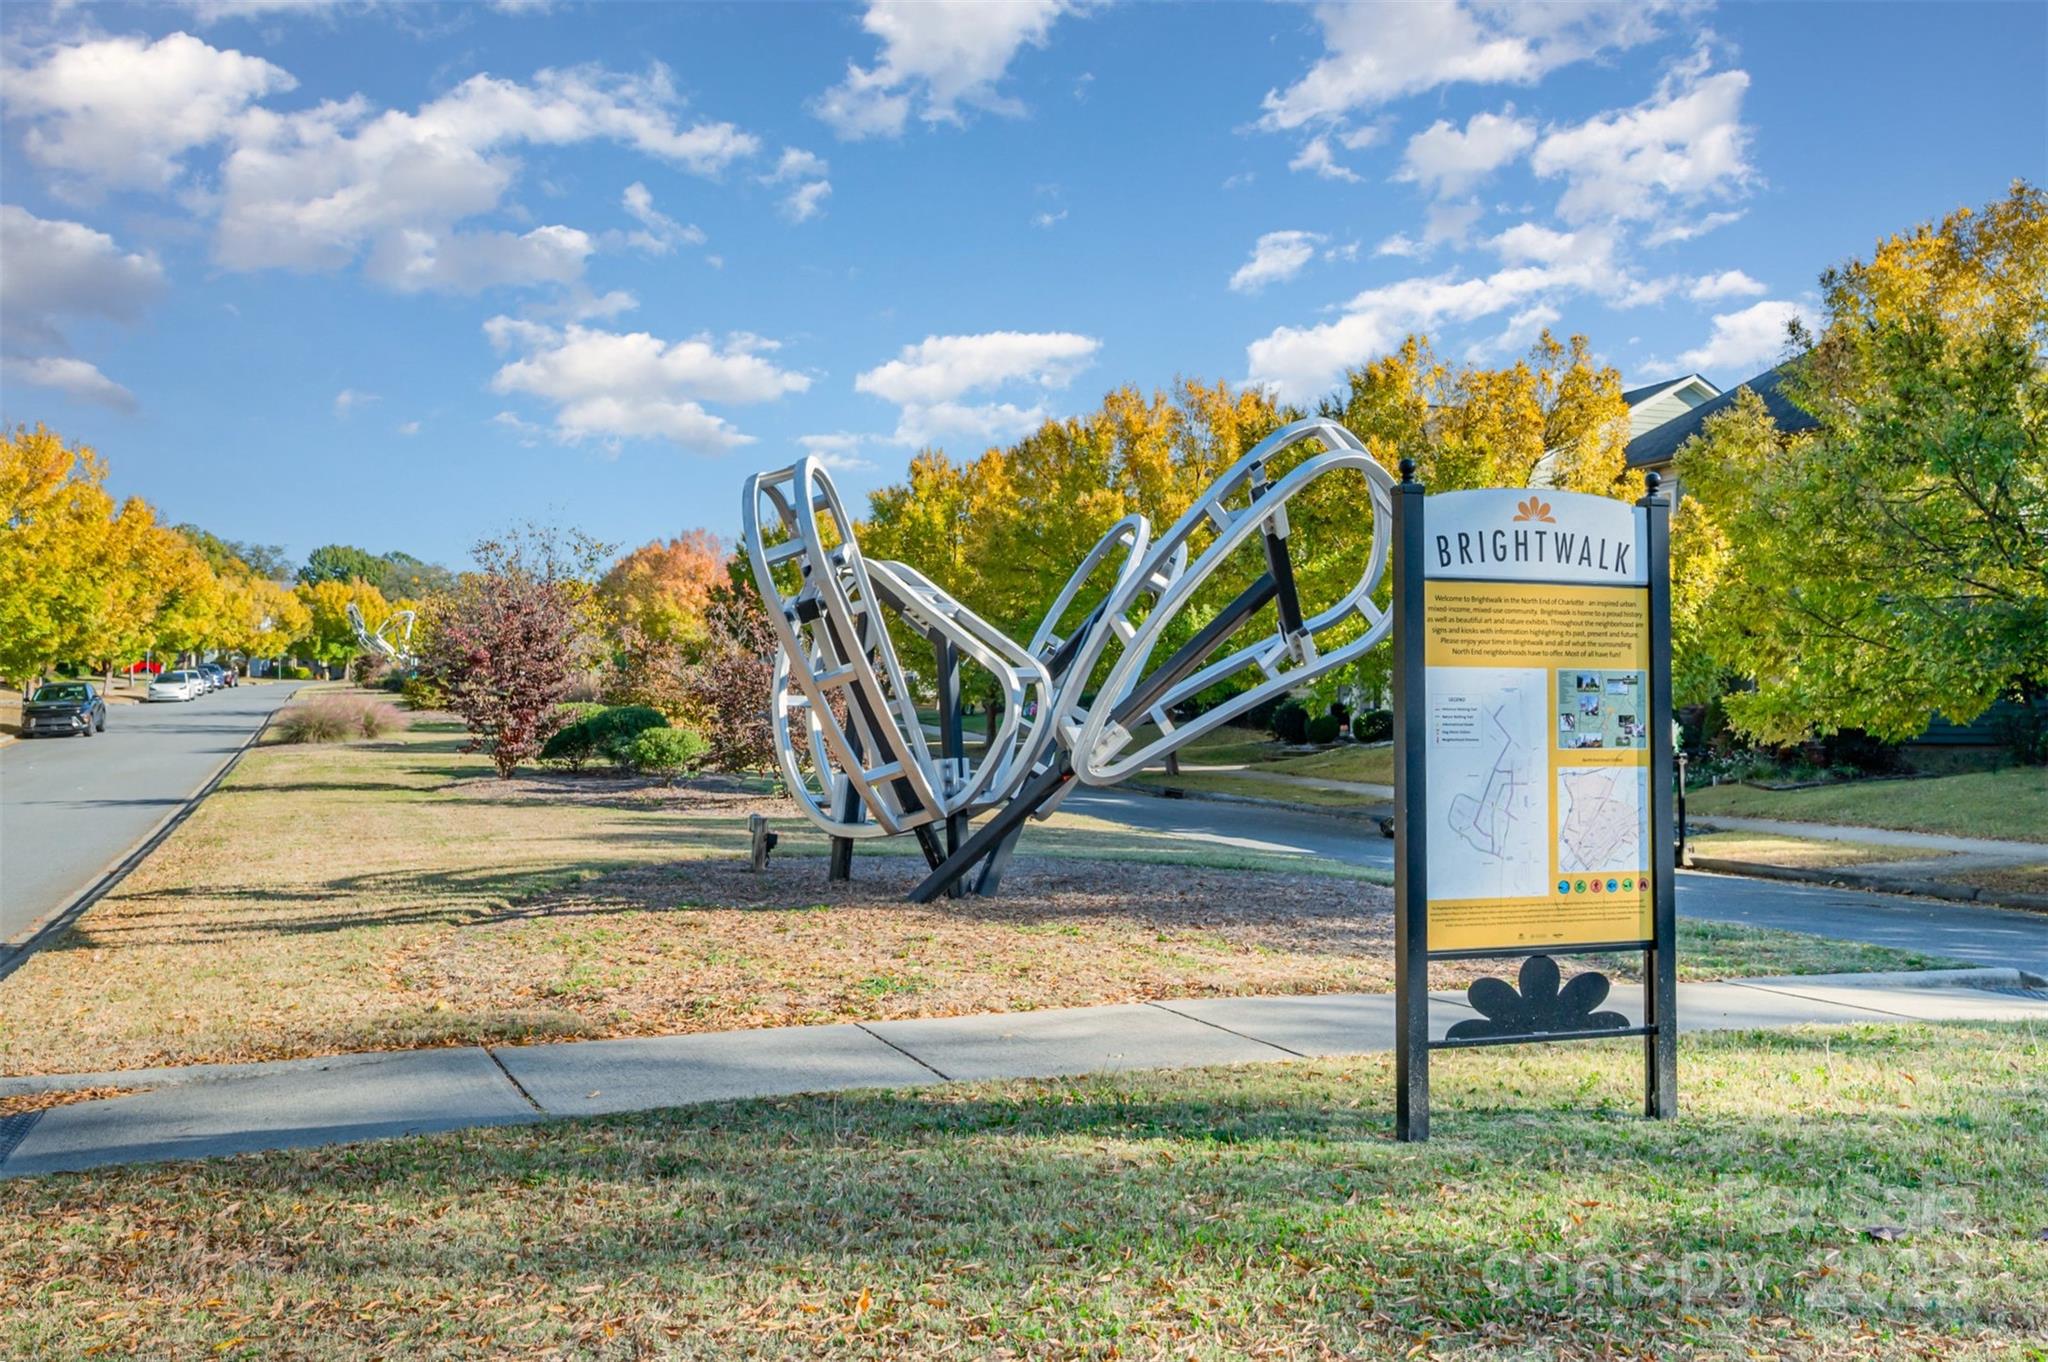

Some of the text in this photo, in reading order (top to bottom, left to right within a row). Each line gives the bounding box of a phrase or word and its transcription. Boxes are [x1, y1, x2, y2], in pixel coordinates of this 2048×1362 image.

[1436, 529, 1630, 574] BRIGHTWALK
[1471, 596, 1502, 604] Brightwalk
[1541, 608, 1570, 616] Brightwalk
[1550, 620, 1583, 628] Throughout
[1595, 620, 1634, 628] neighborhood
[1530, 629, 1563, 638] highlighting
[1513, 639, 1543, 647] Brightwalk
[1598, 641, 1632, 649] surrounding
[1483, 649, 1526, 657] neighborhoods
